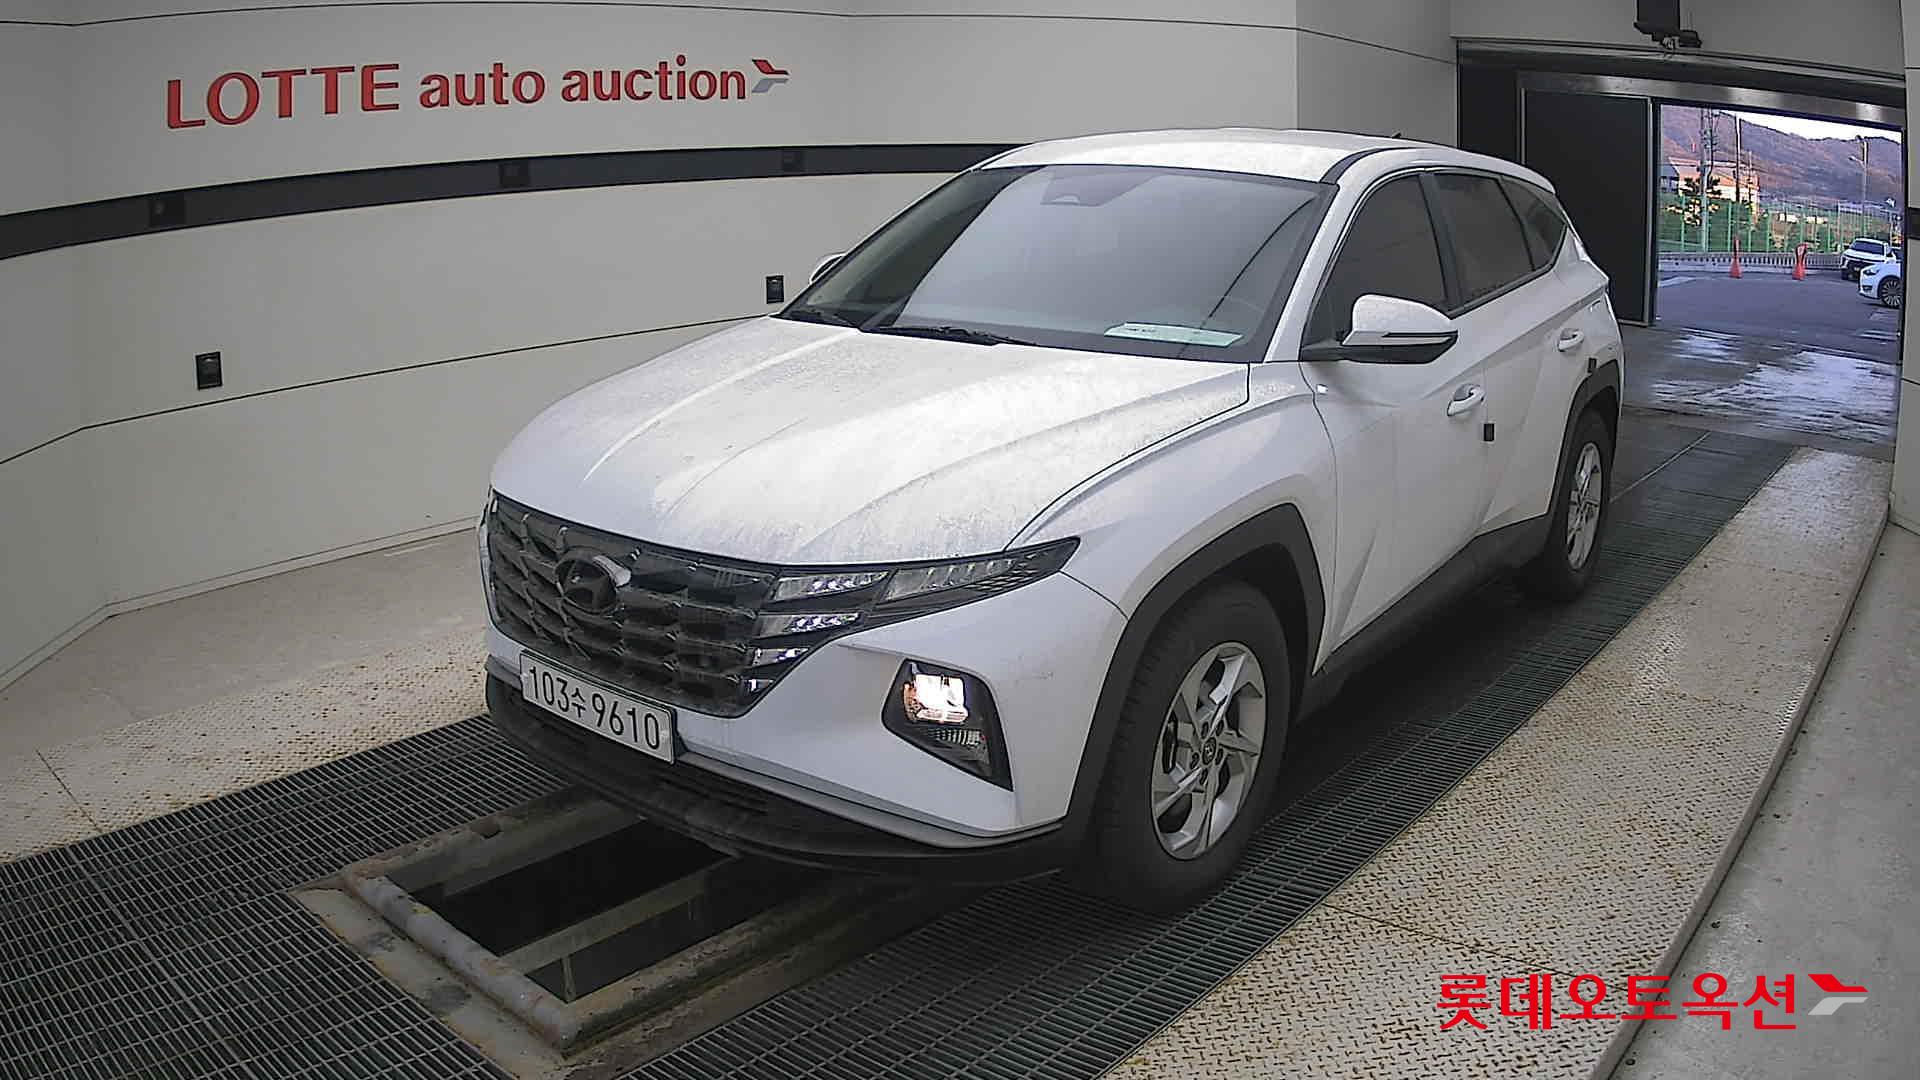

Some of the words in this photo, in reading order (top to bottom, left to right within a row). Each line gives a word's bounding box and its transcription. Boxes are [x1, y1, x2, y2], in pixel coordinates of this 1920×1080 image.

[166, 63, 400, 129] LOTTE
[419, 62, 546, 108] auto
[561, 54, 747, 101] auction
